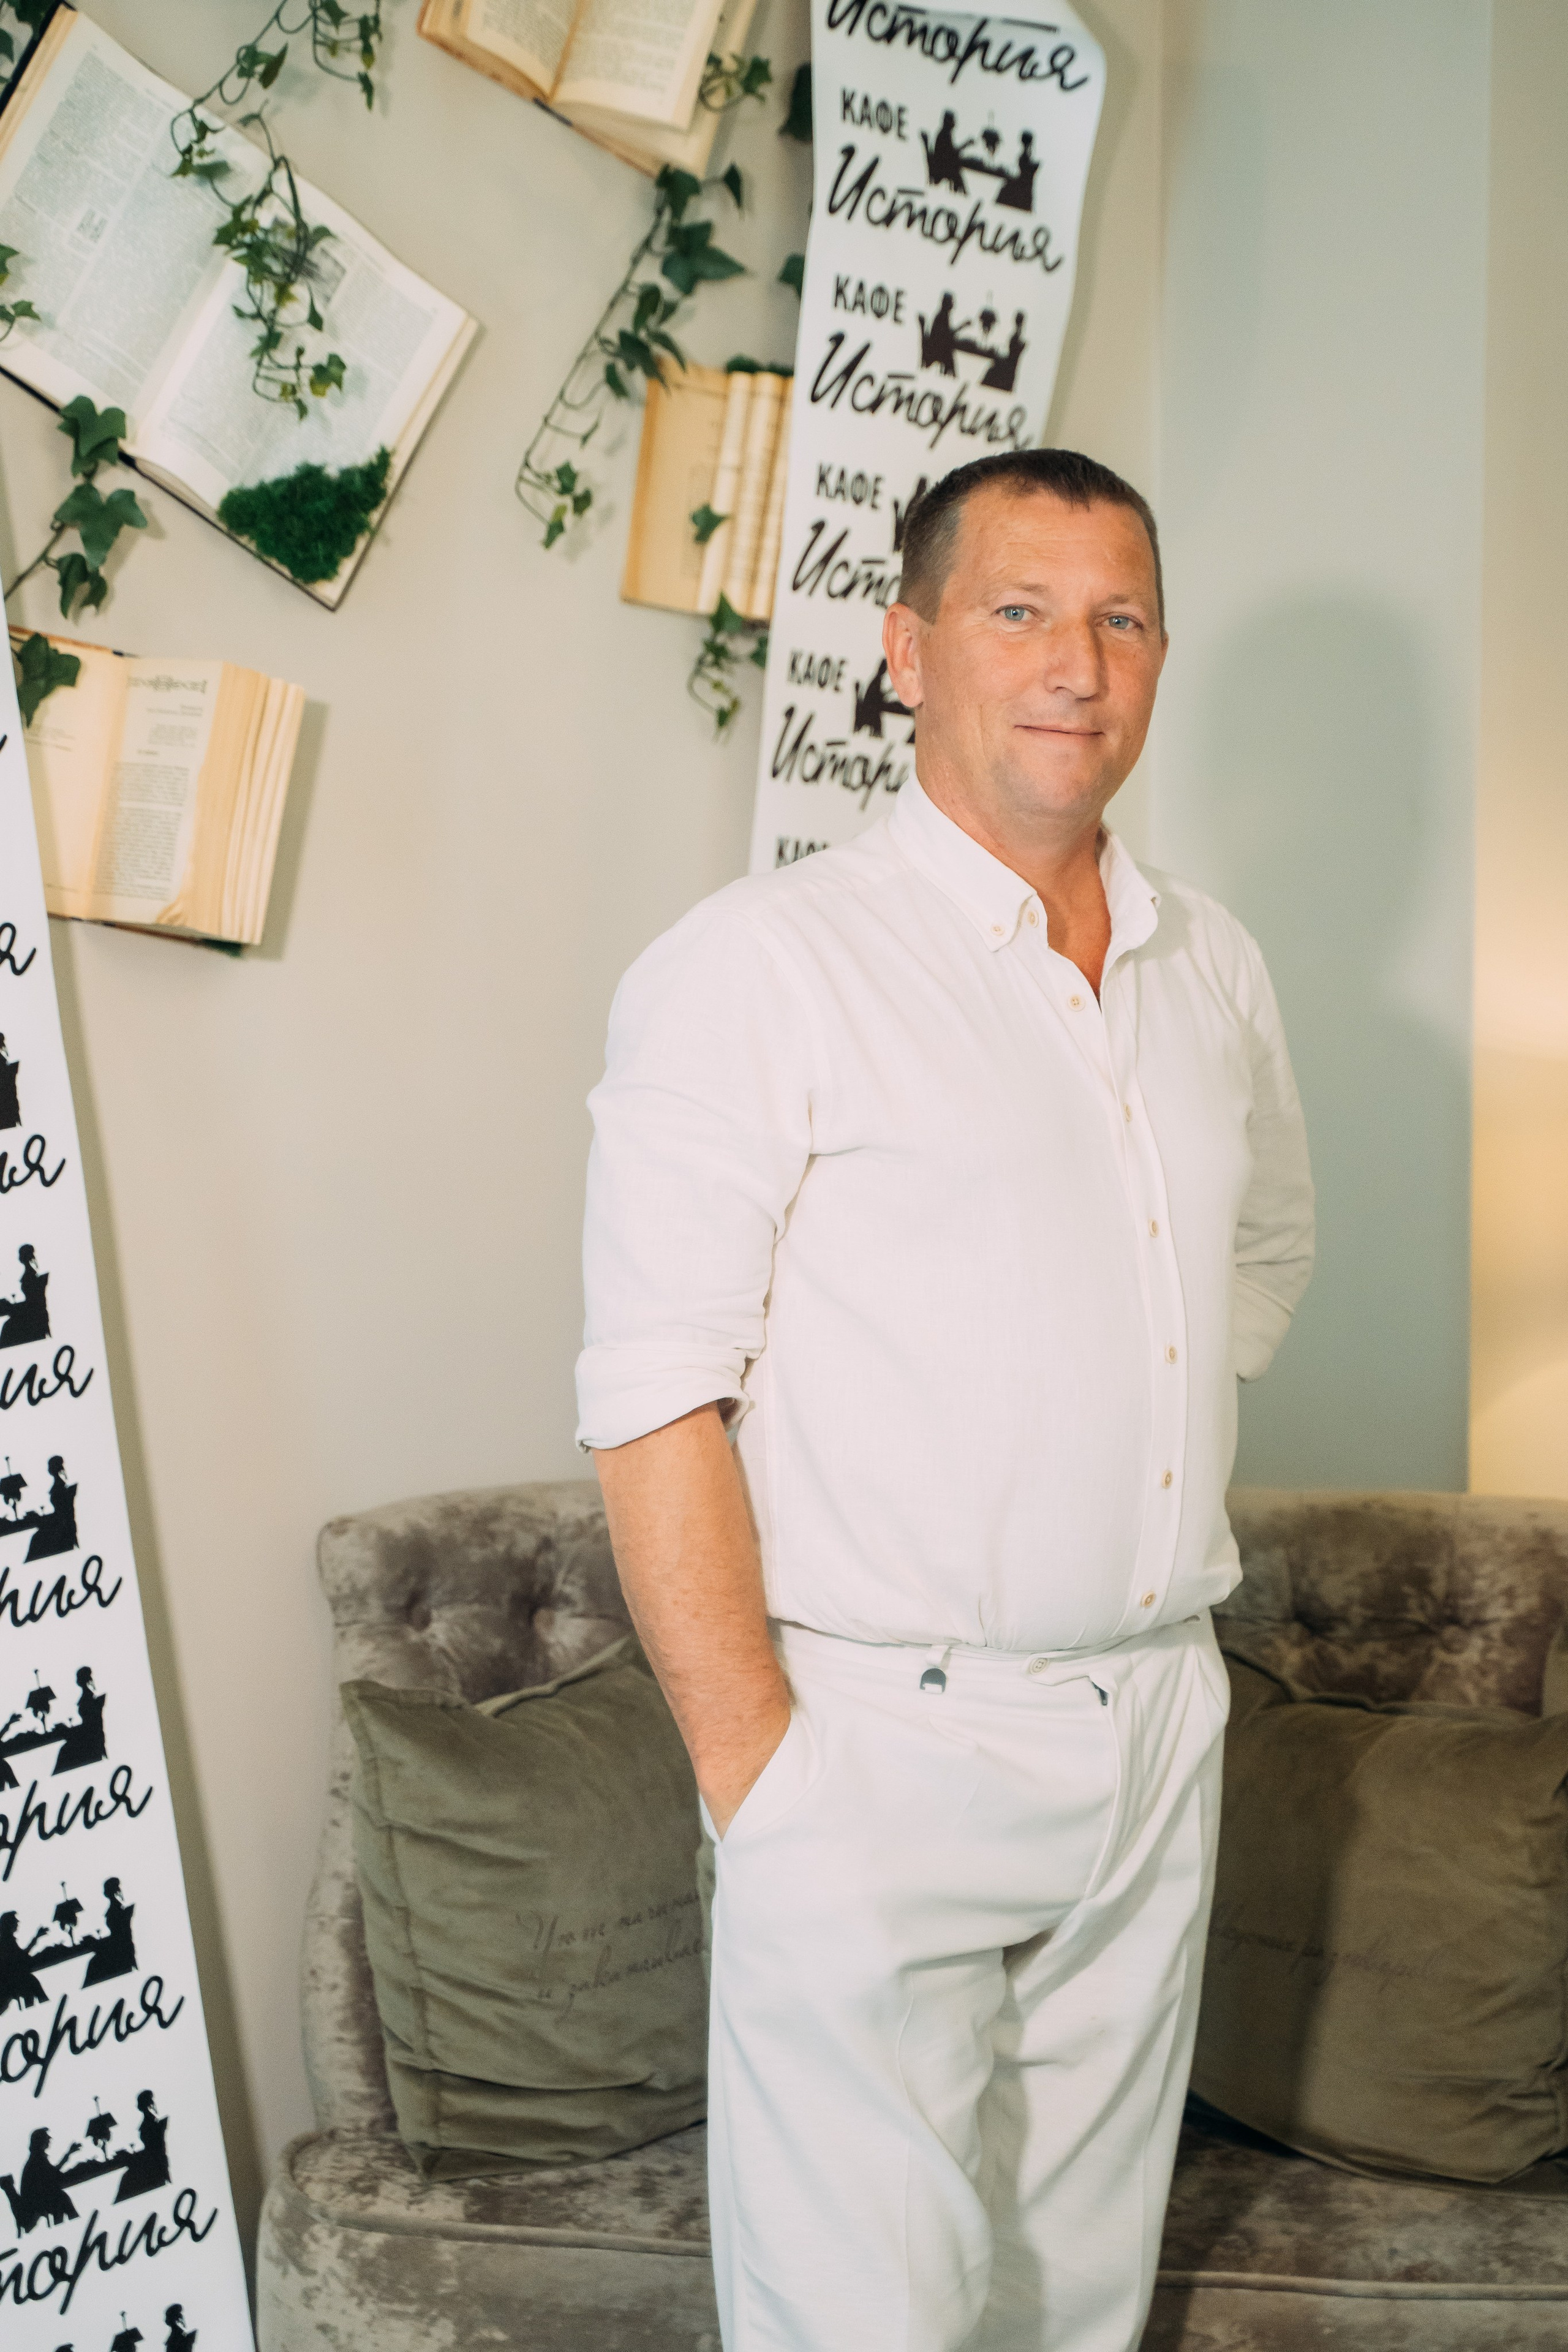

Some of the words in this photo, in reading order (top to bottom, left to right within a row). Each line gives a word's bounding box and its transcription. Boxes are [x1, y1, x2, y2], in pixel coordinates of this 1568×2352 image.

[842, 88, 908, 141] КАФЕ
[828, 144, 1065, 272] История
[834, 273, 907, 324] КАФЕ
[810, 332, 1033, 451] История
[816, 462, 883, 510] КАФЕ
[787, 650, 847, 693] КАФЕ
[0, 1975, 185, 2098] ория
